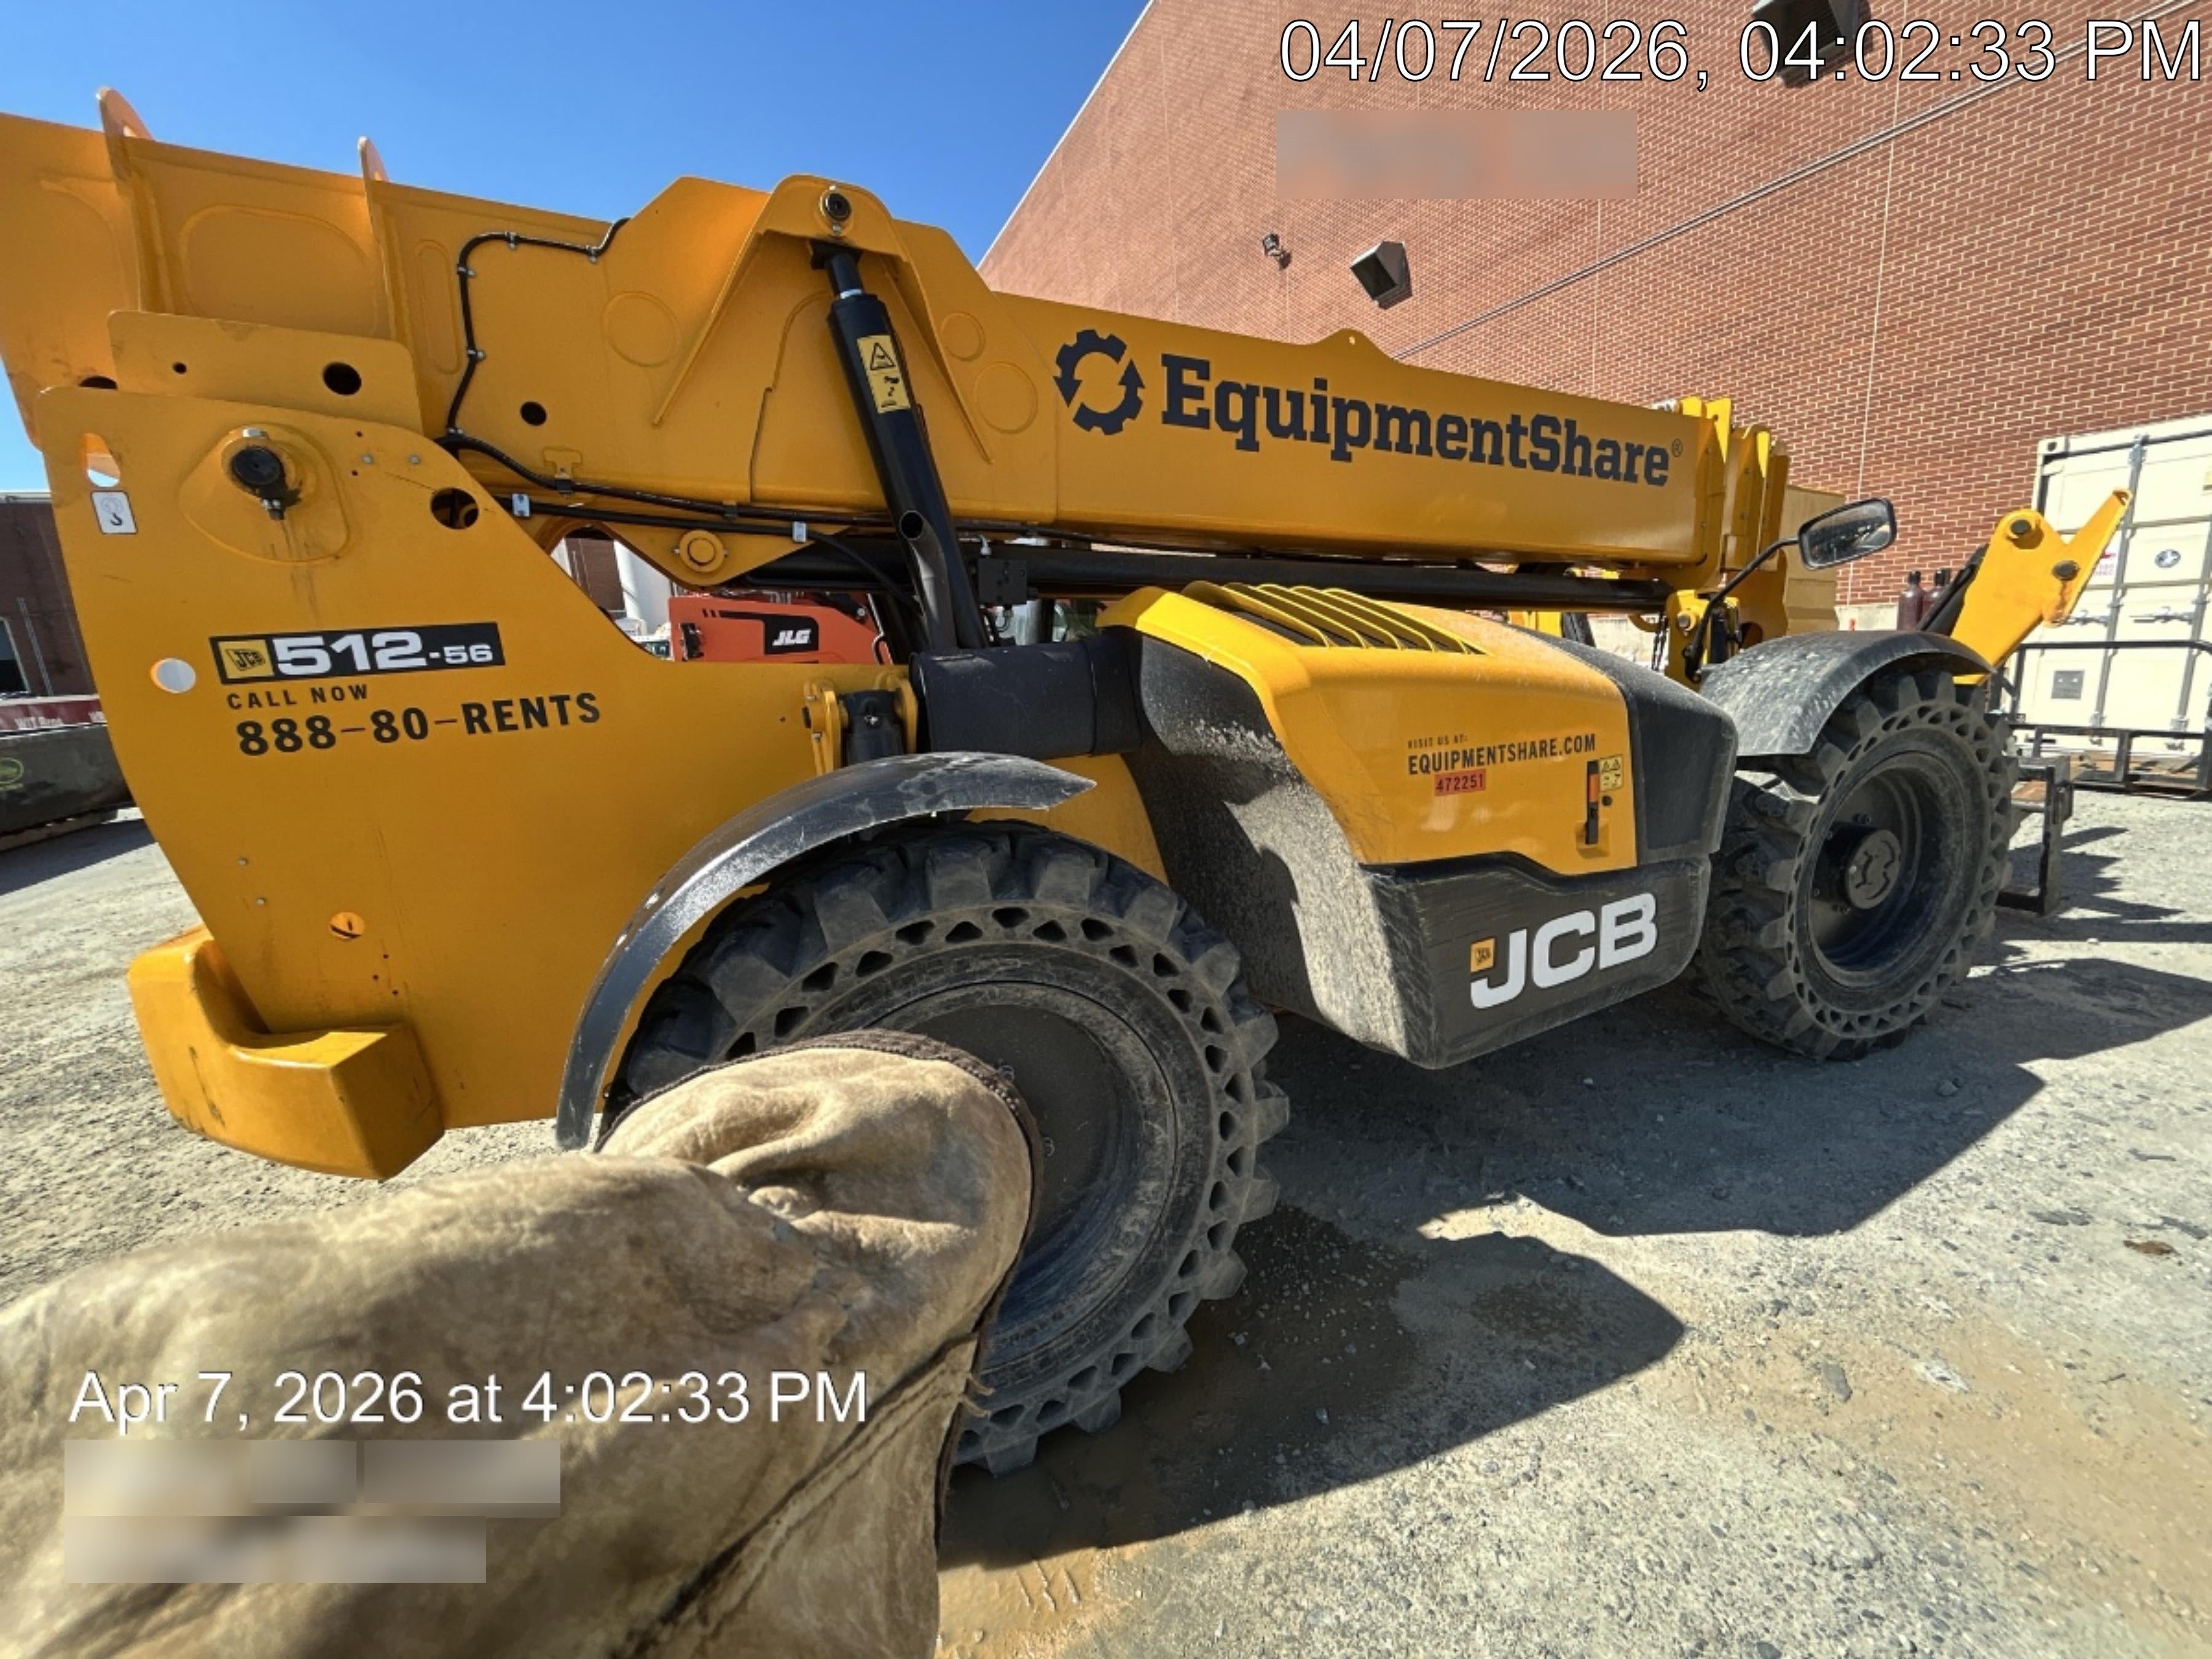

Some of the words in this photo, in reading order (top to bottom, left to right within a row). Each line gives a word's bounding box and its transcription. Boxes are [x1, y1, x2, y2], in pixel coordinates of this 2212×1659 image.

[772, 629, 812, 646] JLG
[227, 690, 297, 710] CALL
[311, 684, 367, 703] NOW
[1408, 734, 1595, 775] EQUIPMENTSHARE.COM
[1435, 774, 1483, 791] 472251
[1471, 893, 1658, 1009] JCB
